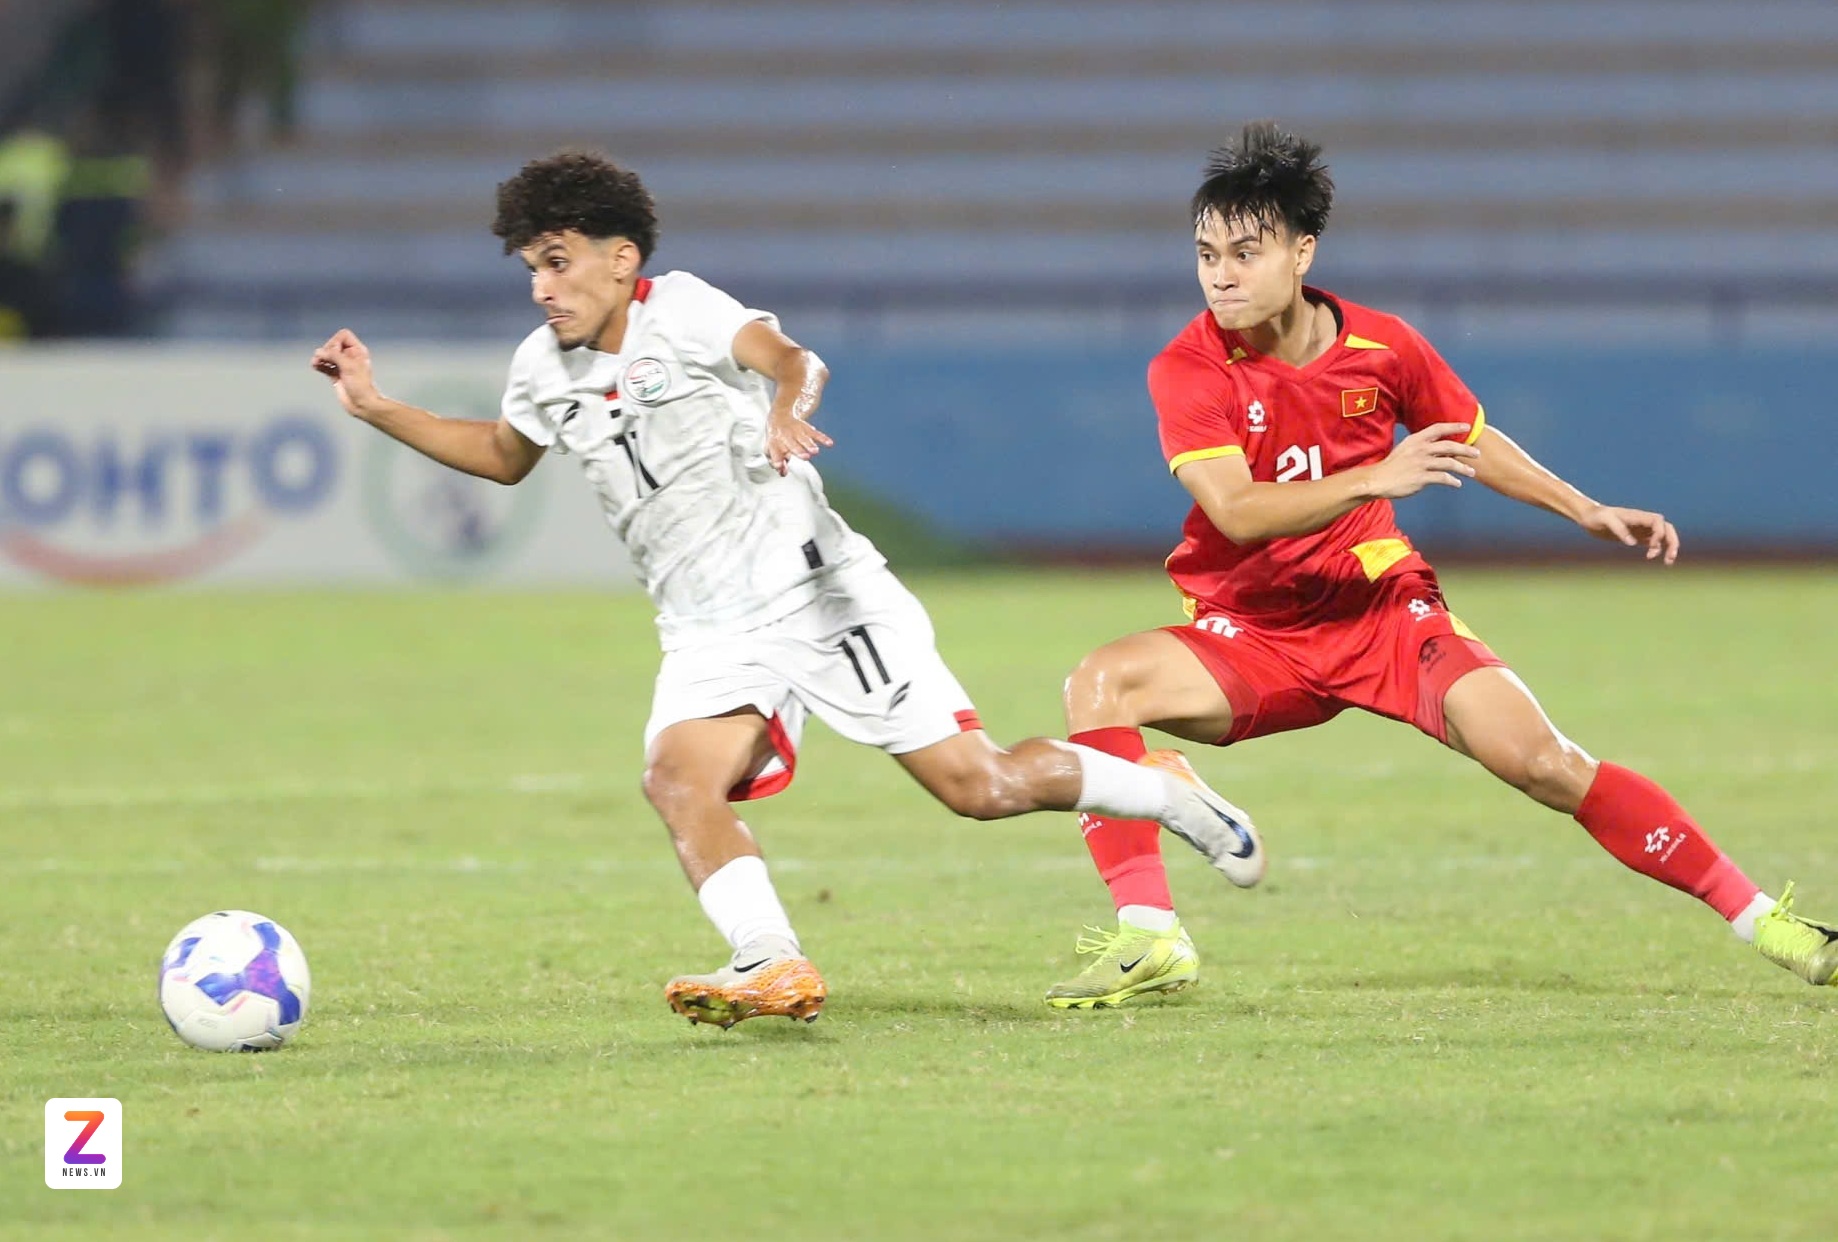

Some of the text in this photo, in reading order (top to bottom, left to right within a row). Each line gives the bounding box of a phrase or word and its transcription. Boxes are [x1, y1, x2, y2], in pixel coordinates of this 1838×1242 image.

[0, 408, 340, 532] OHTO
[1276, 444, 1323, 484] 21
[834, 625, 892, 694] 11
